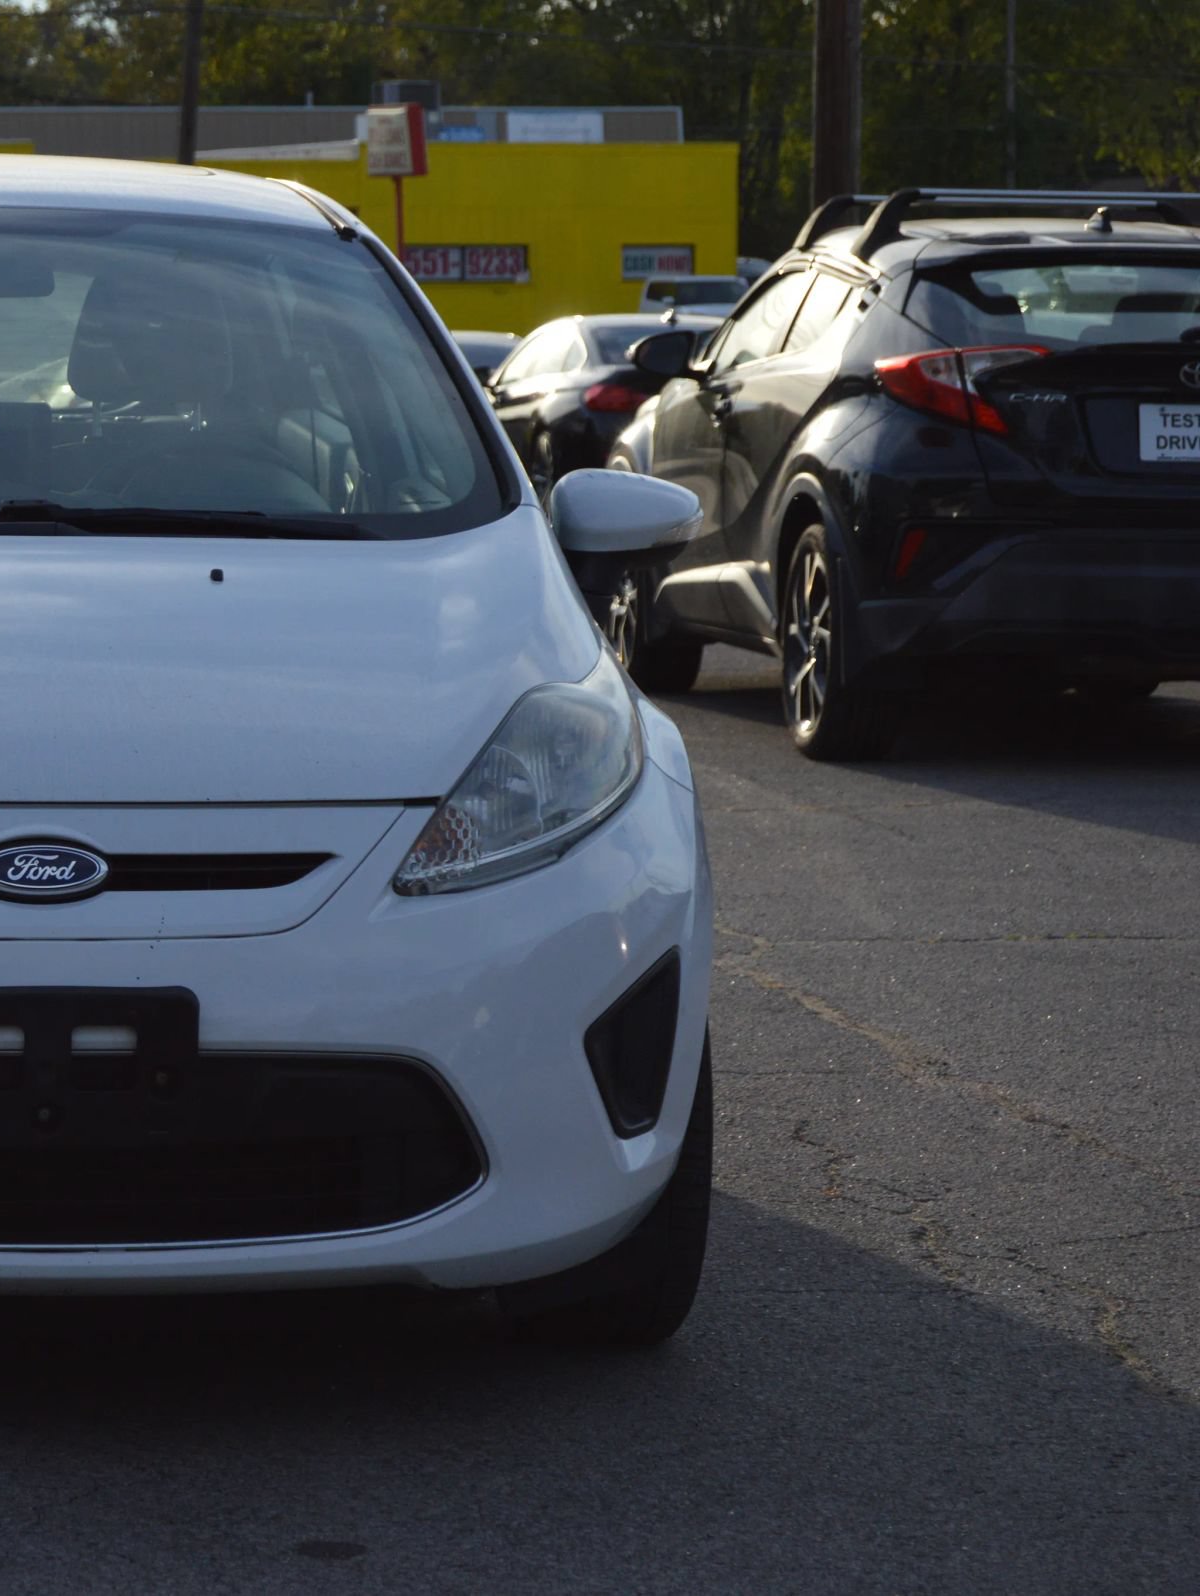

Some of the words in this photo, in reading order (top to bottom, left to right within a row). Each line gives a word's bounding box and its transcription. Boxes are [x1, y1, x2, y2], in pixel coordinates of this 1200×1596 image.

[624, 255, 653, 271] CASH
[1009, 392, 1067, 402] C-HR
[1160, 413, 1200, 428] TEST
[1156, 435, 1200, 450] DRIV
[7, 853, 75, 881] Ford
